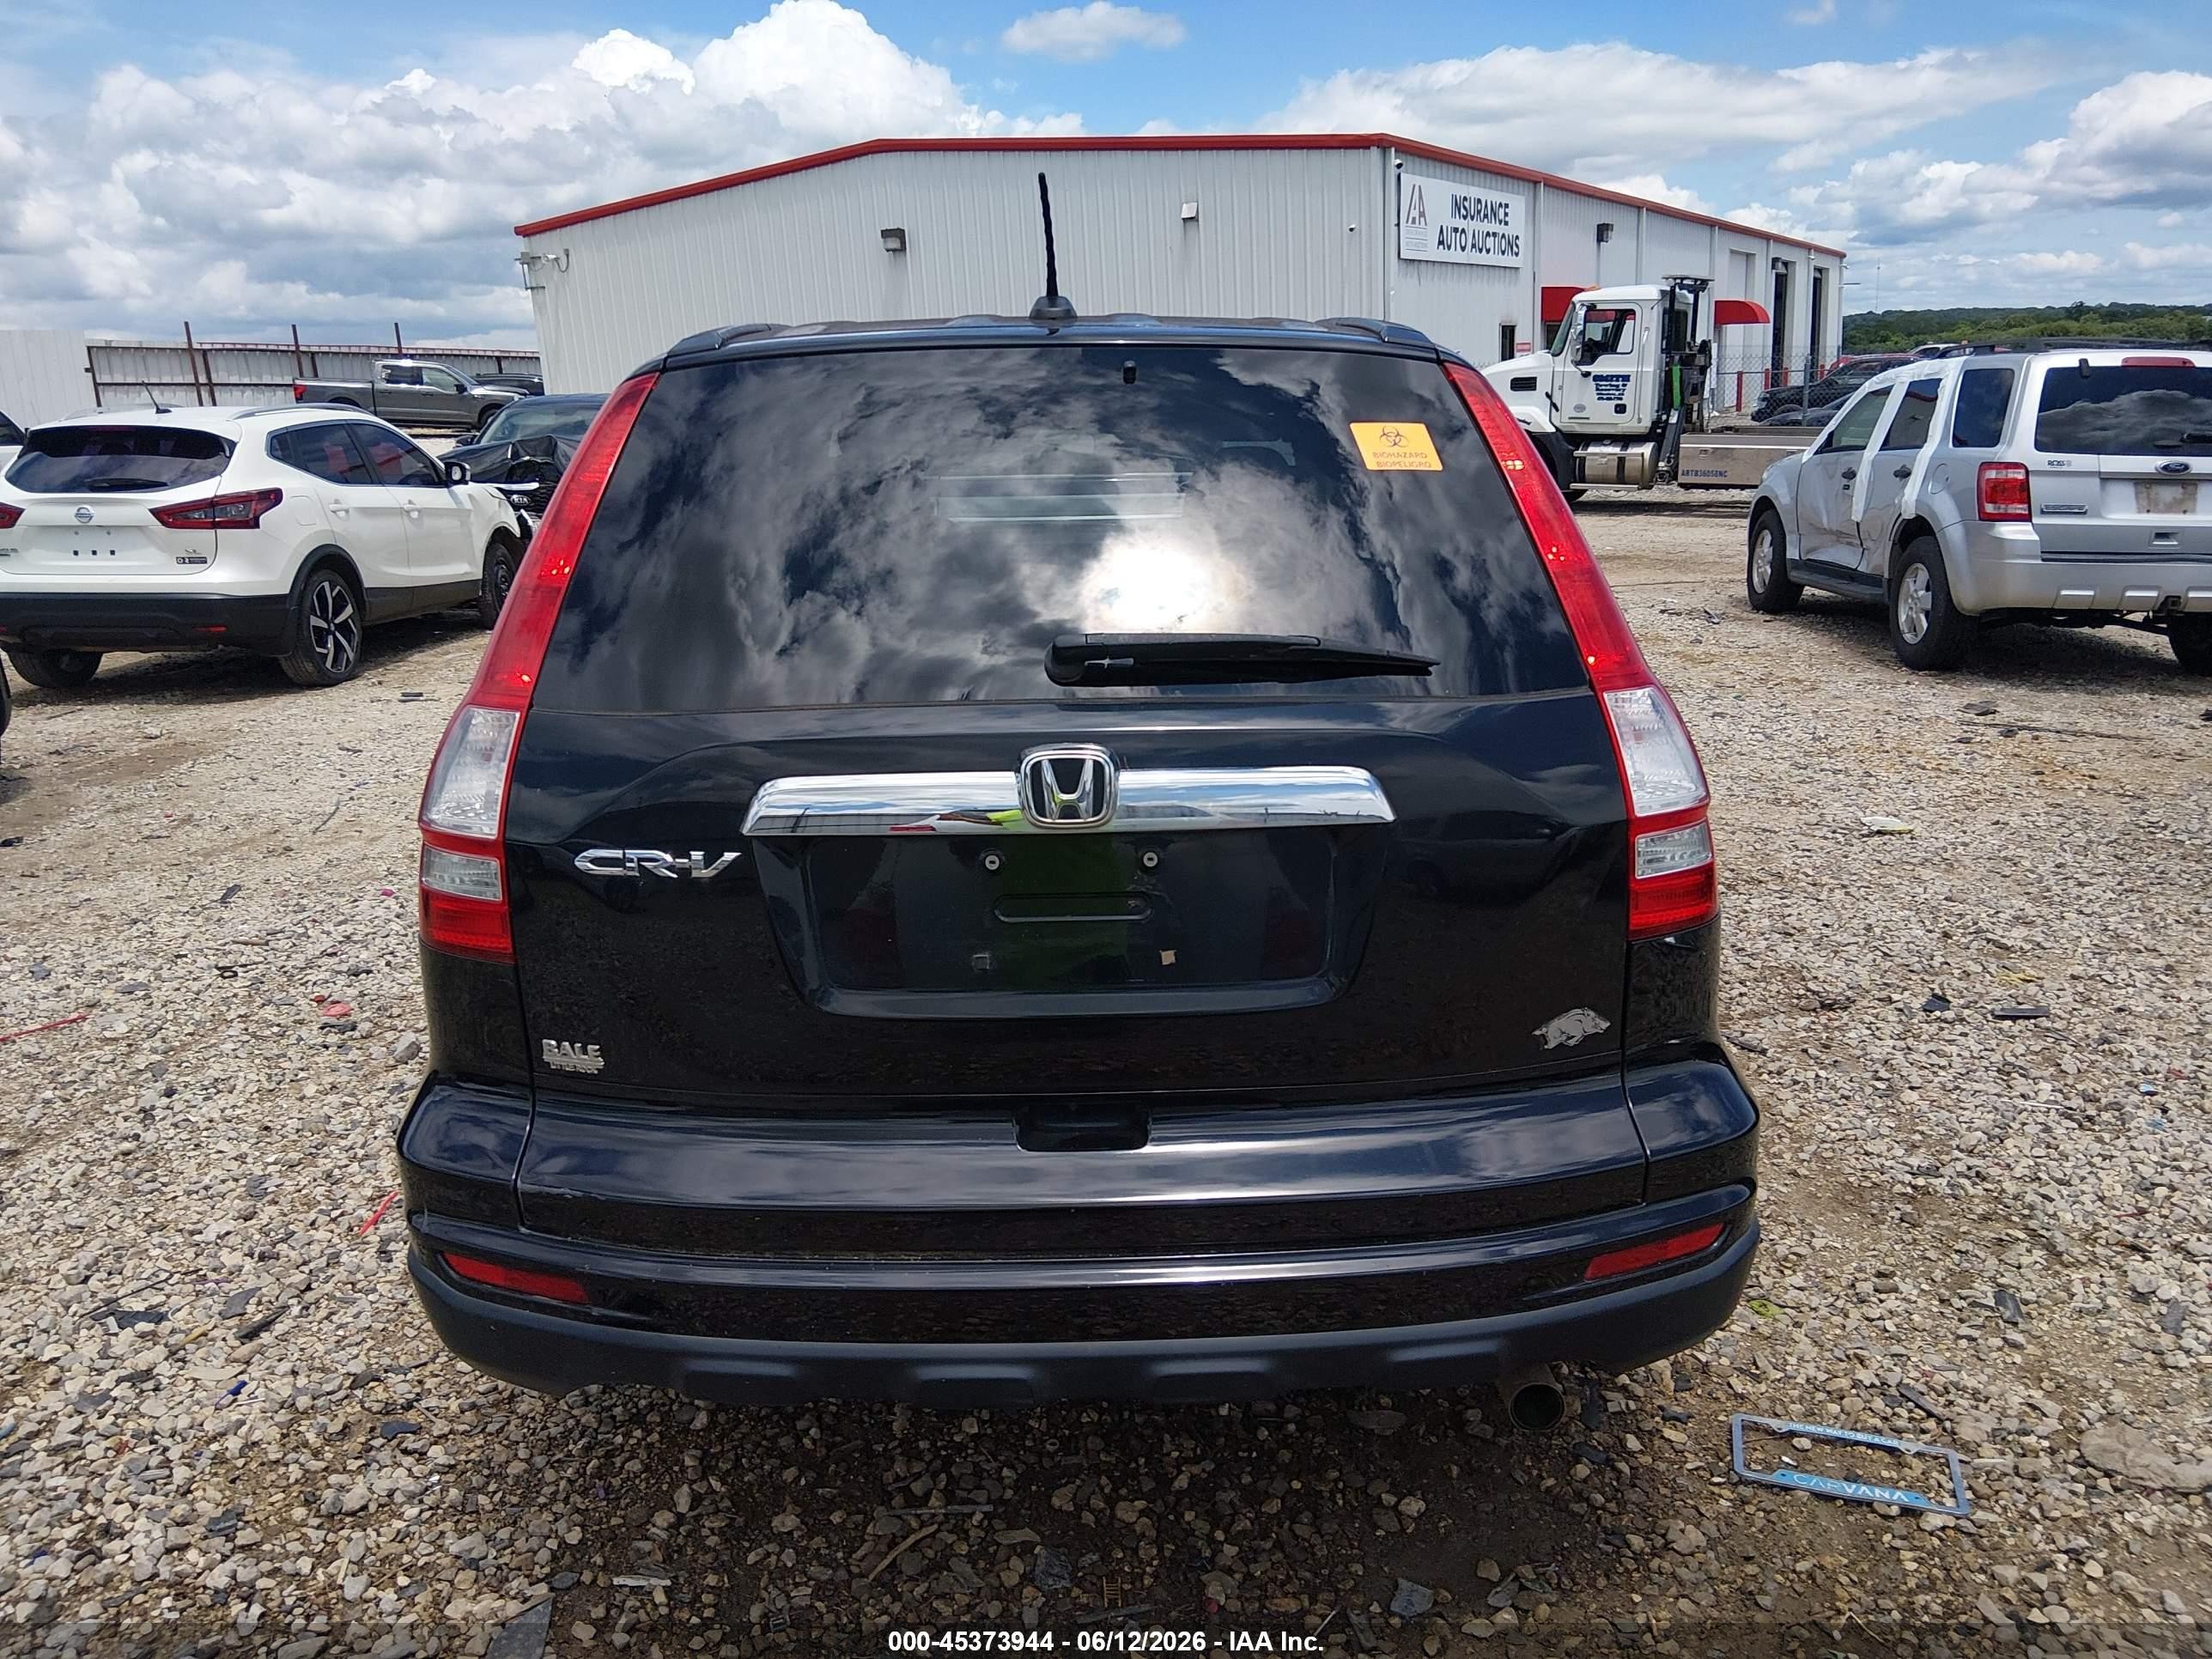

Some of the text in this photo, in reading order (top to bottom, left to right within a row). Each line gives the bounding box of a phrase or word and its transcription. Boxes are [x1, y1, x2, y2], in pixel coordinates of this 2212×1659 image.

[1450, 193, 1510, 226] INSURANCE
[1437, 225, 1520, 258] AUTO AUCTIONS
[574, 848, 742, 878] CR-V
[542, 1038, 604, 1062] BALE
[1789, 1422, 1802, 1431] THE
[1793, 1474, 1909, 1502] CARVANA
